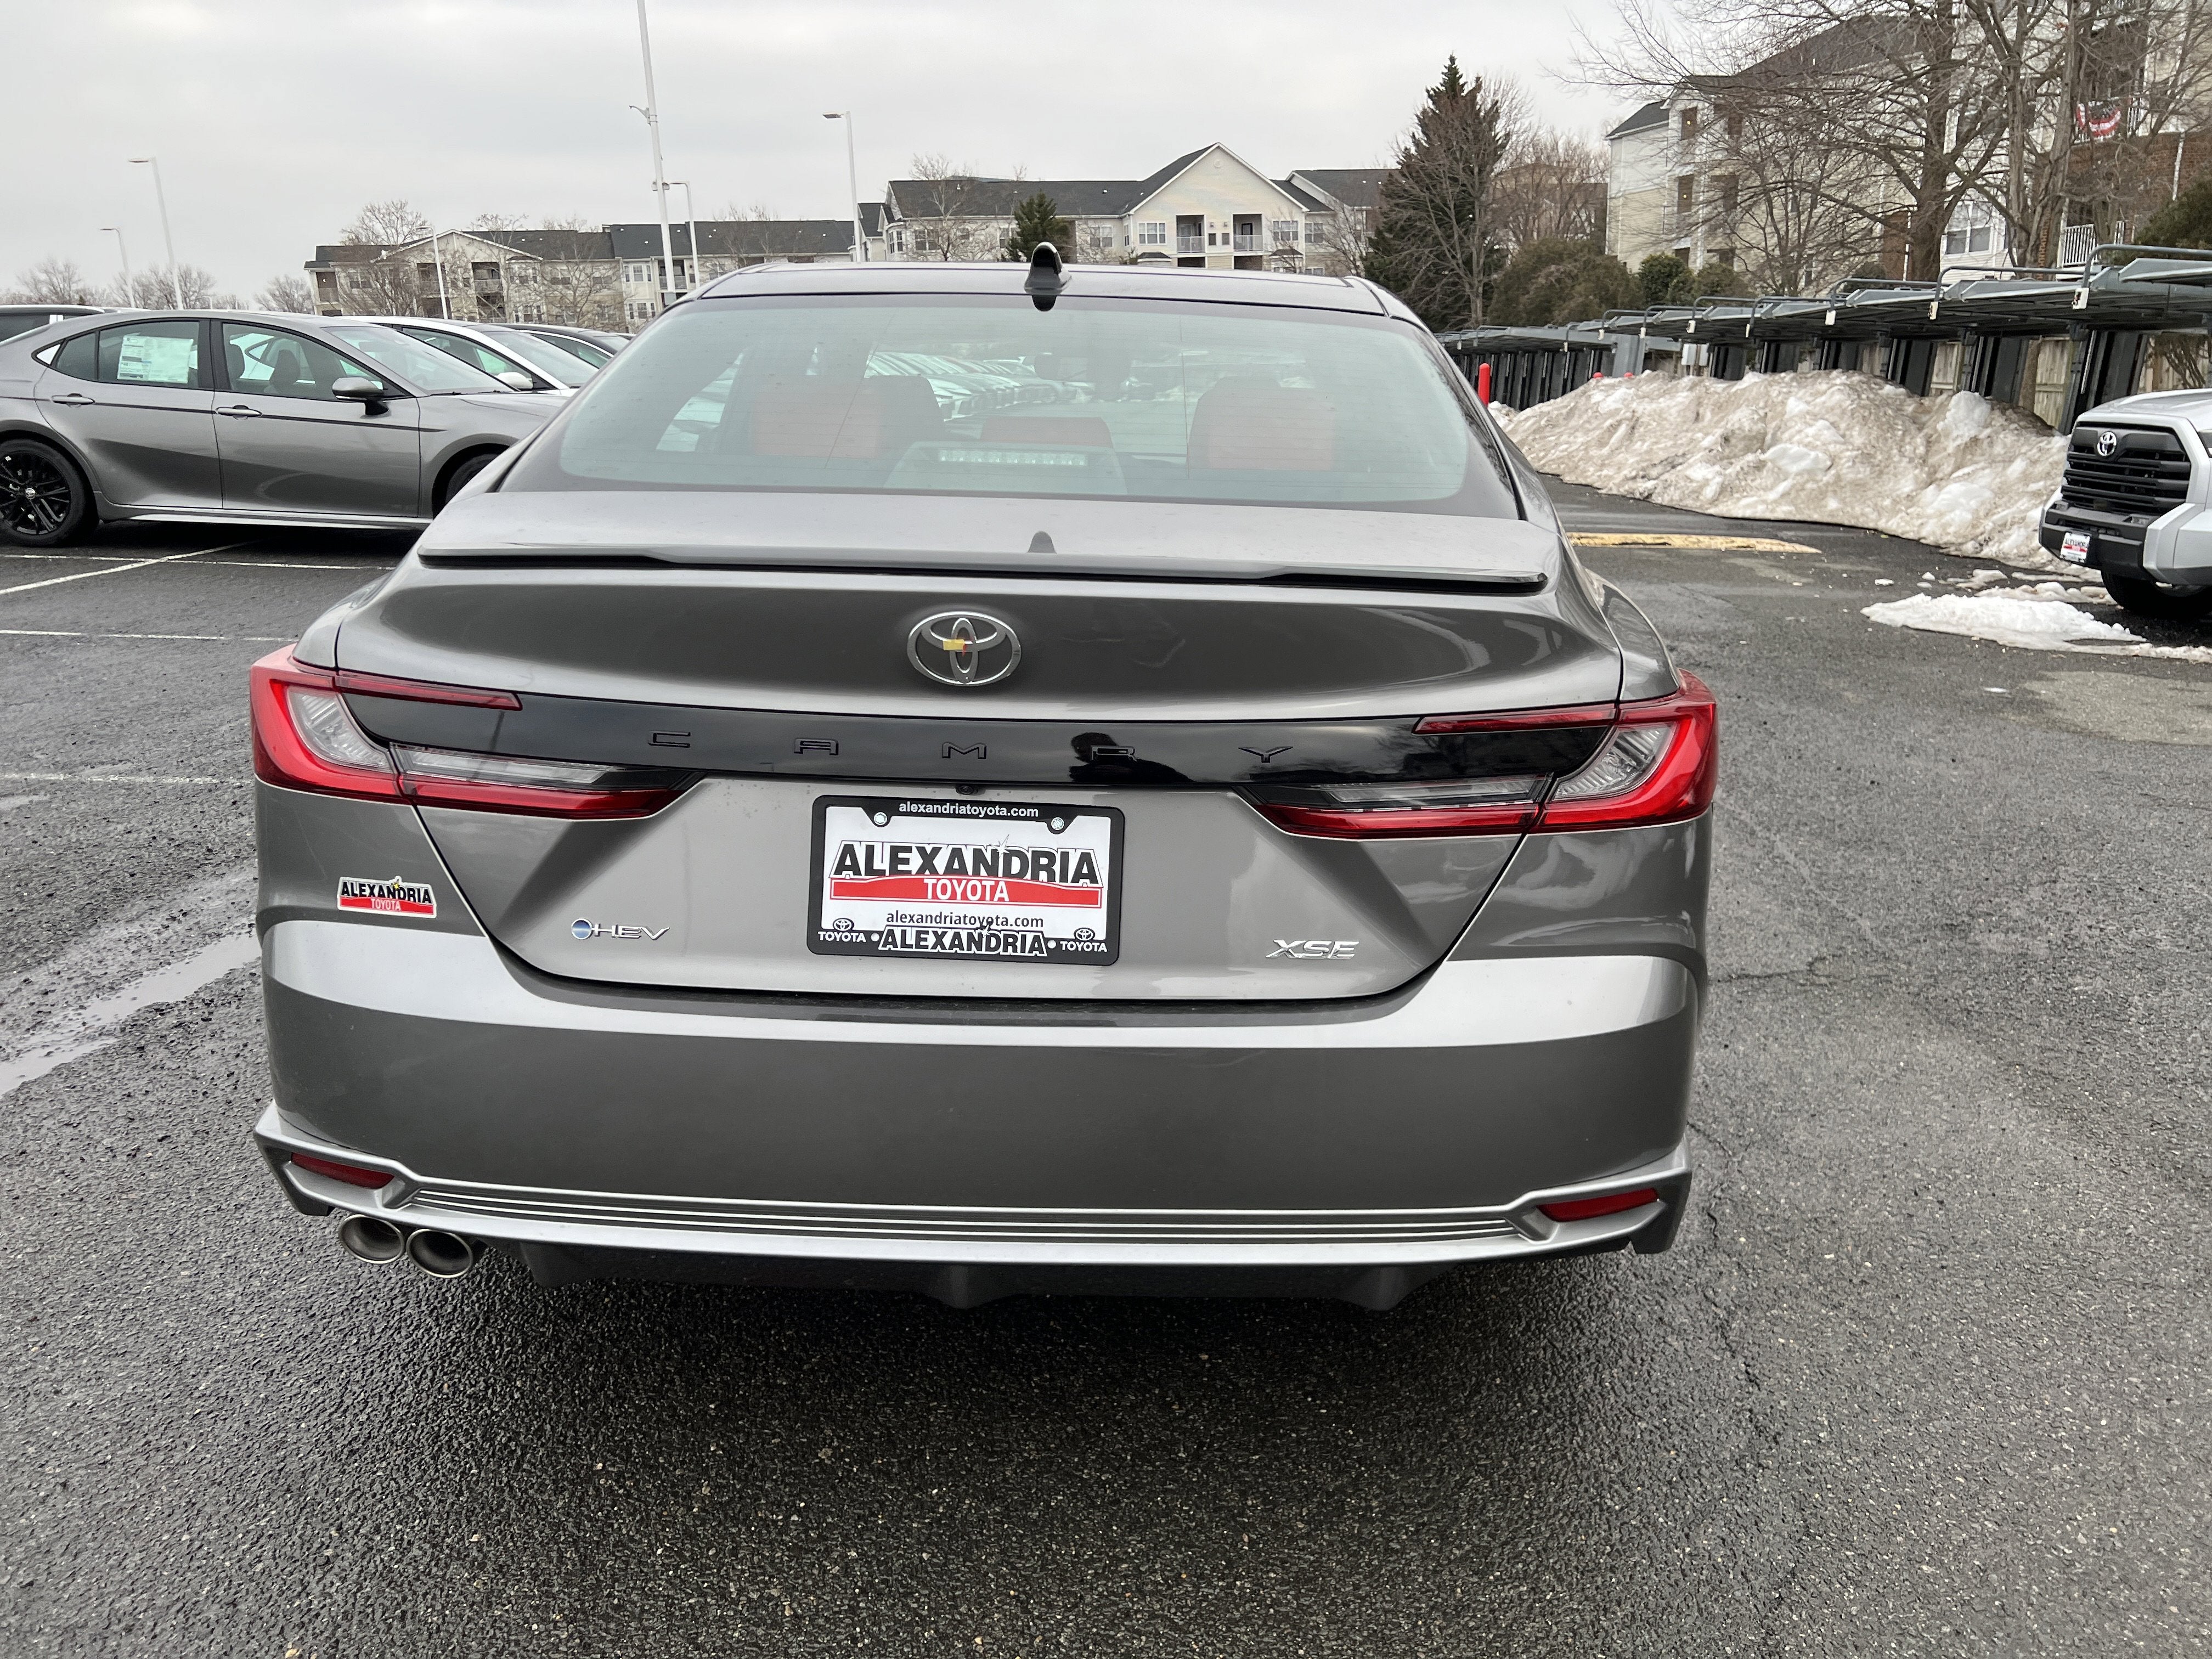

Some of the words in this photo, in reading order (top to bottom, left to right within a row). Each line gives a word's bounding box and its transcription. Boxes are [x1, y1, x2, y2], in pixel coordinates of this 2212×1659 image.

[647, 730, 1294, 763] CAMRY
[898, 801, 1039, 818] alexandriatoyota.com
[832, 842, 1101, 886] ALEXANDRIA
[341, 881, 432, 904] ALEXANDRIA
[923, 878, 1010, 902] TOYOTA
[370, 898, 401, 911] TOYOTA
[885, 910, 1043, 928] alexandriatoyota.com
[817, 930, 866, 943] TOYOTA
[880, 927, 1046, 956] ALEXANDRIA
[1059, 941, 1108, 952] TOYOTA
[1265, 939, 1359, 960] XSE
